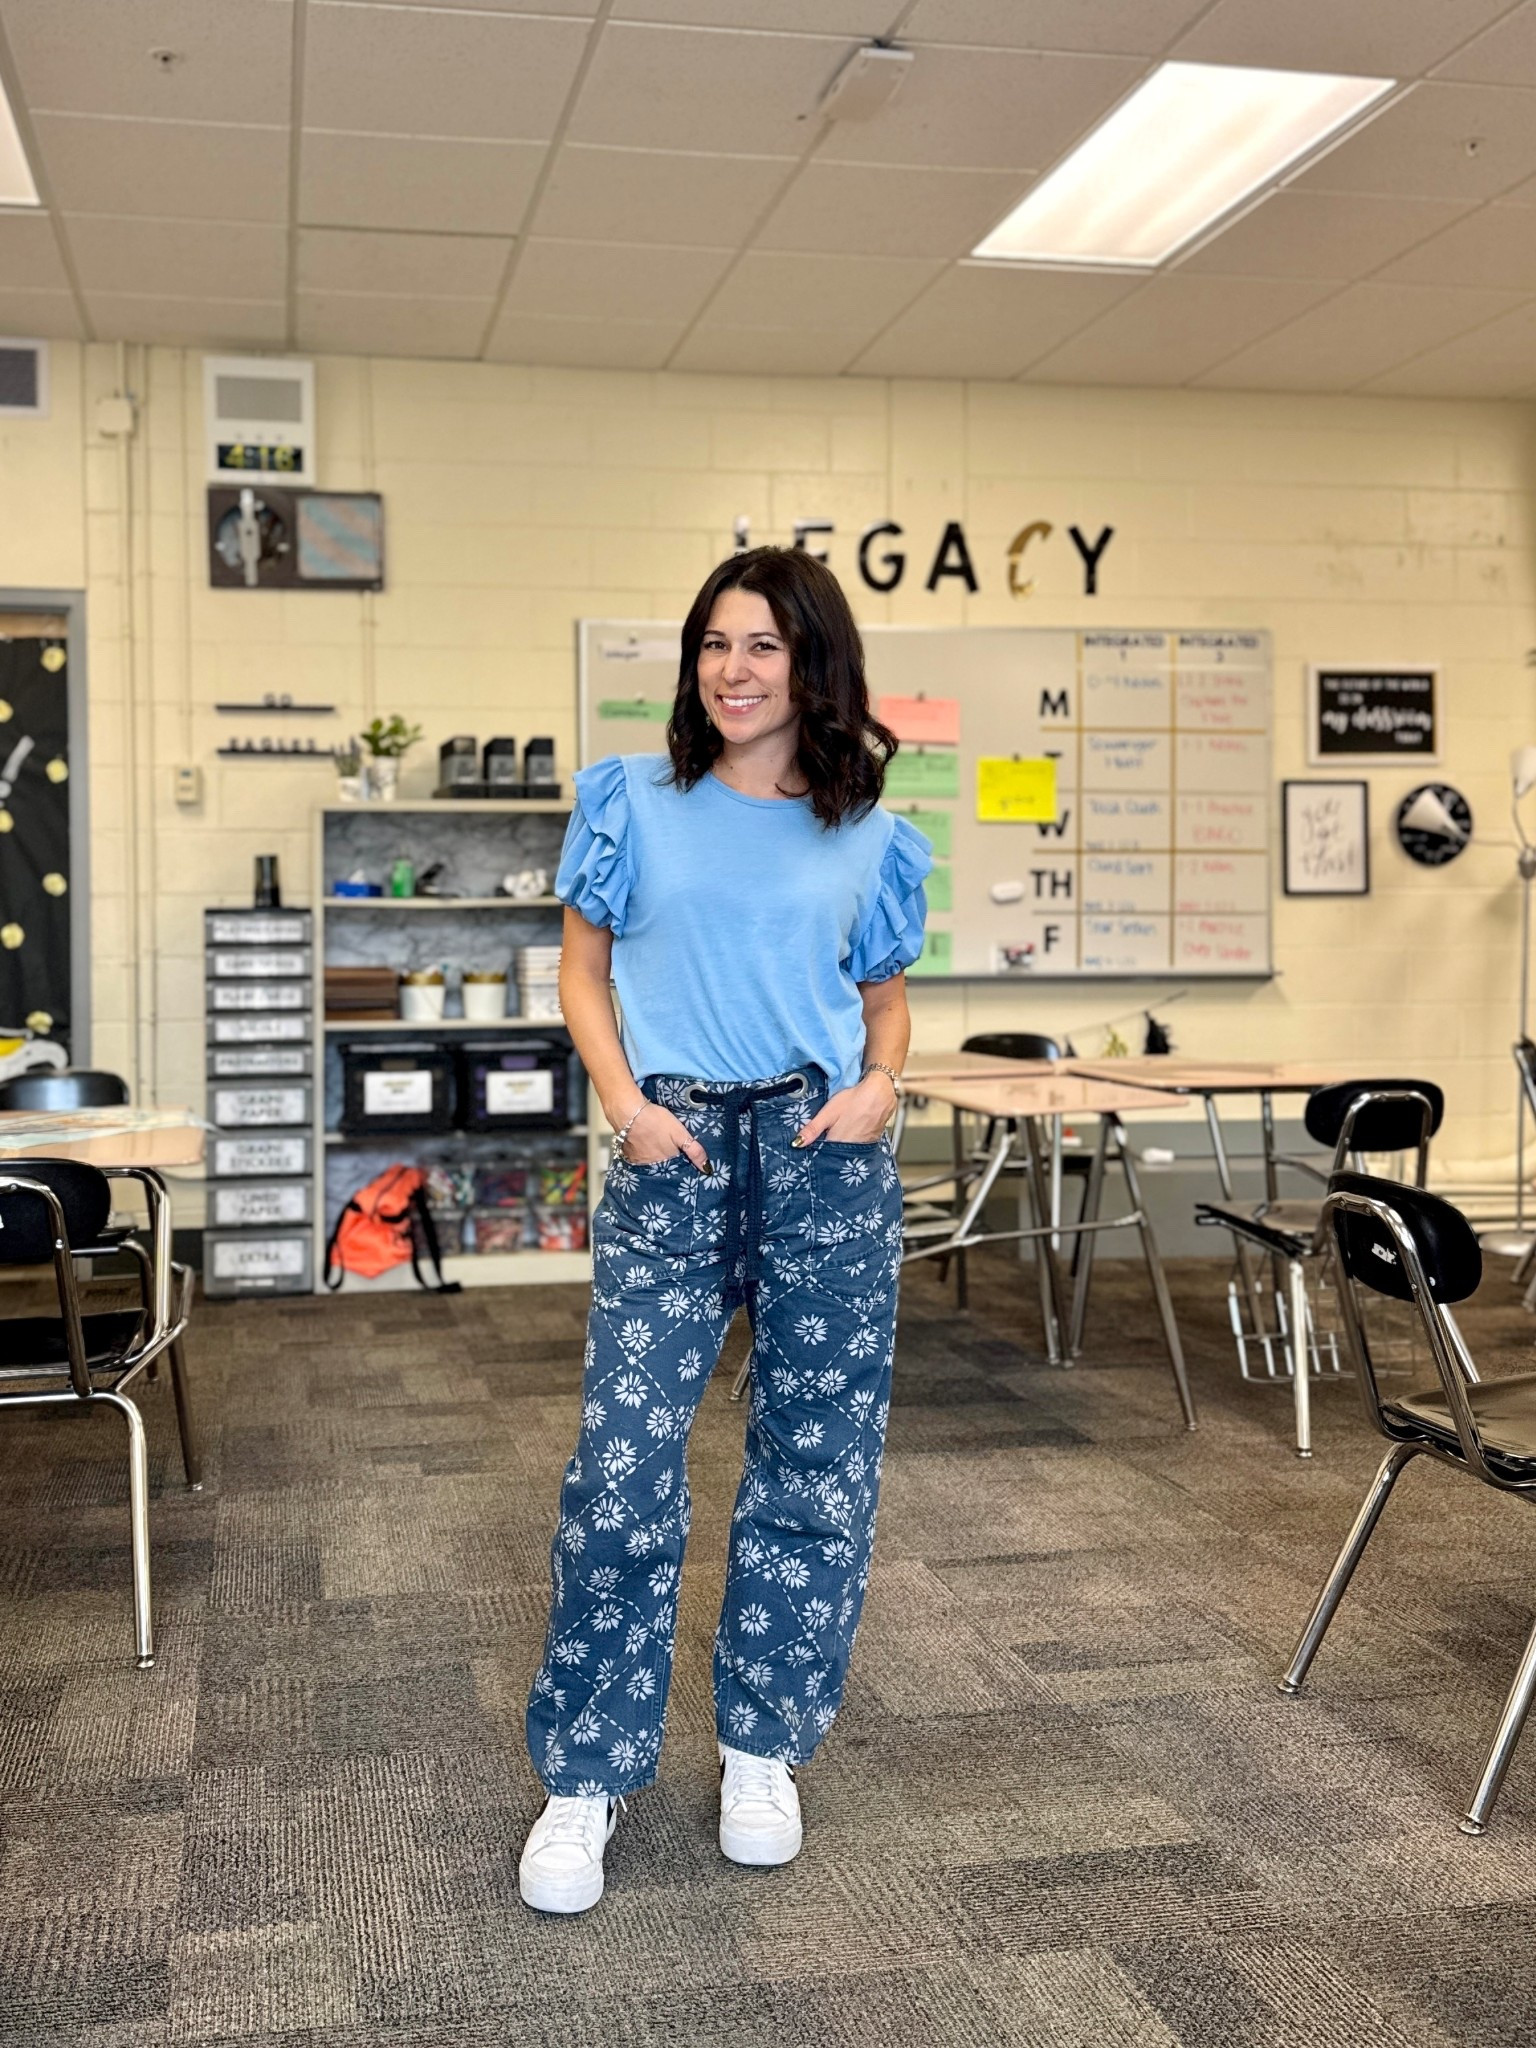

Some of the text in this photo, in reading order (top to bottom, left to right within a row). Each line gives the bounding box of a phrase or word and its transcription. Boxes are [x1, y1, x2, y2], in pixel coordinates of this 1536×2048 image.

[1039, 690, 1069, 717] M
[1030, 869, 1072, 898] TH
[1044, 925, 1060, 953] F
[238, 1251, 281, 1263] EXTRA
